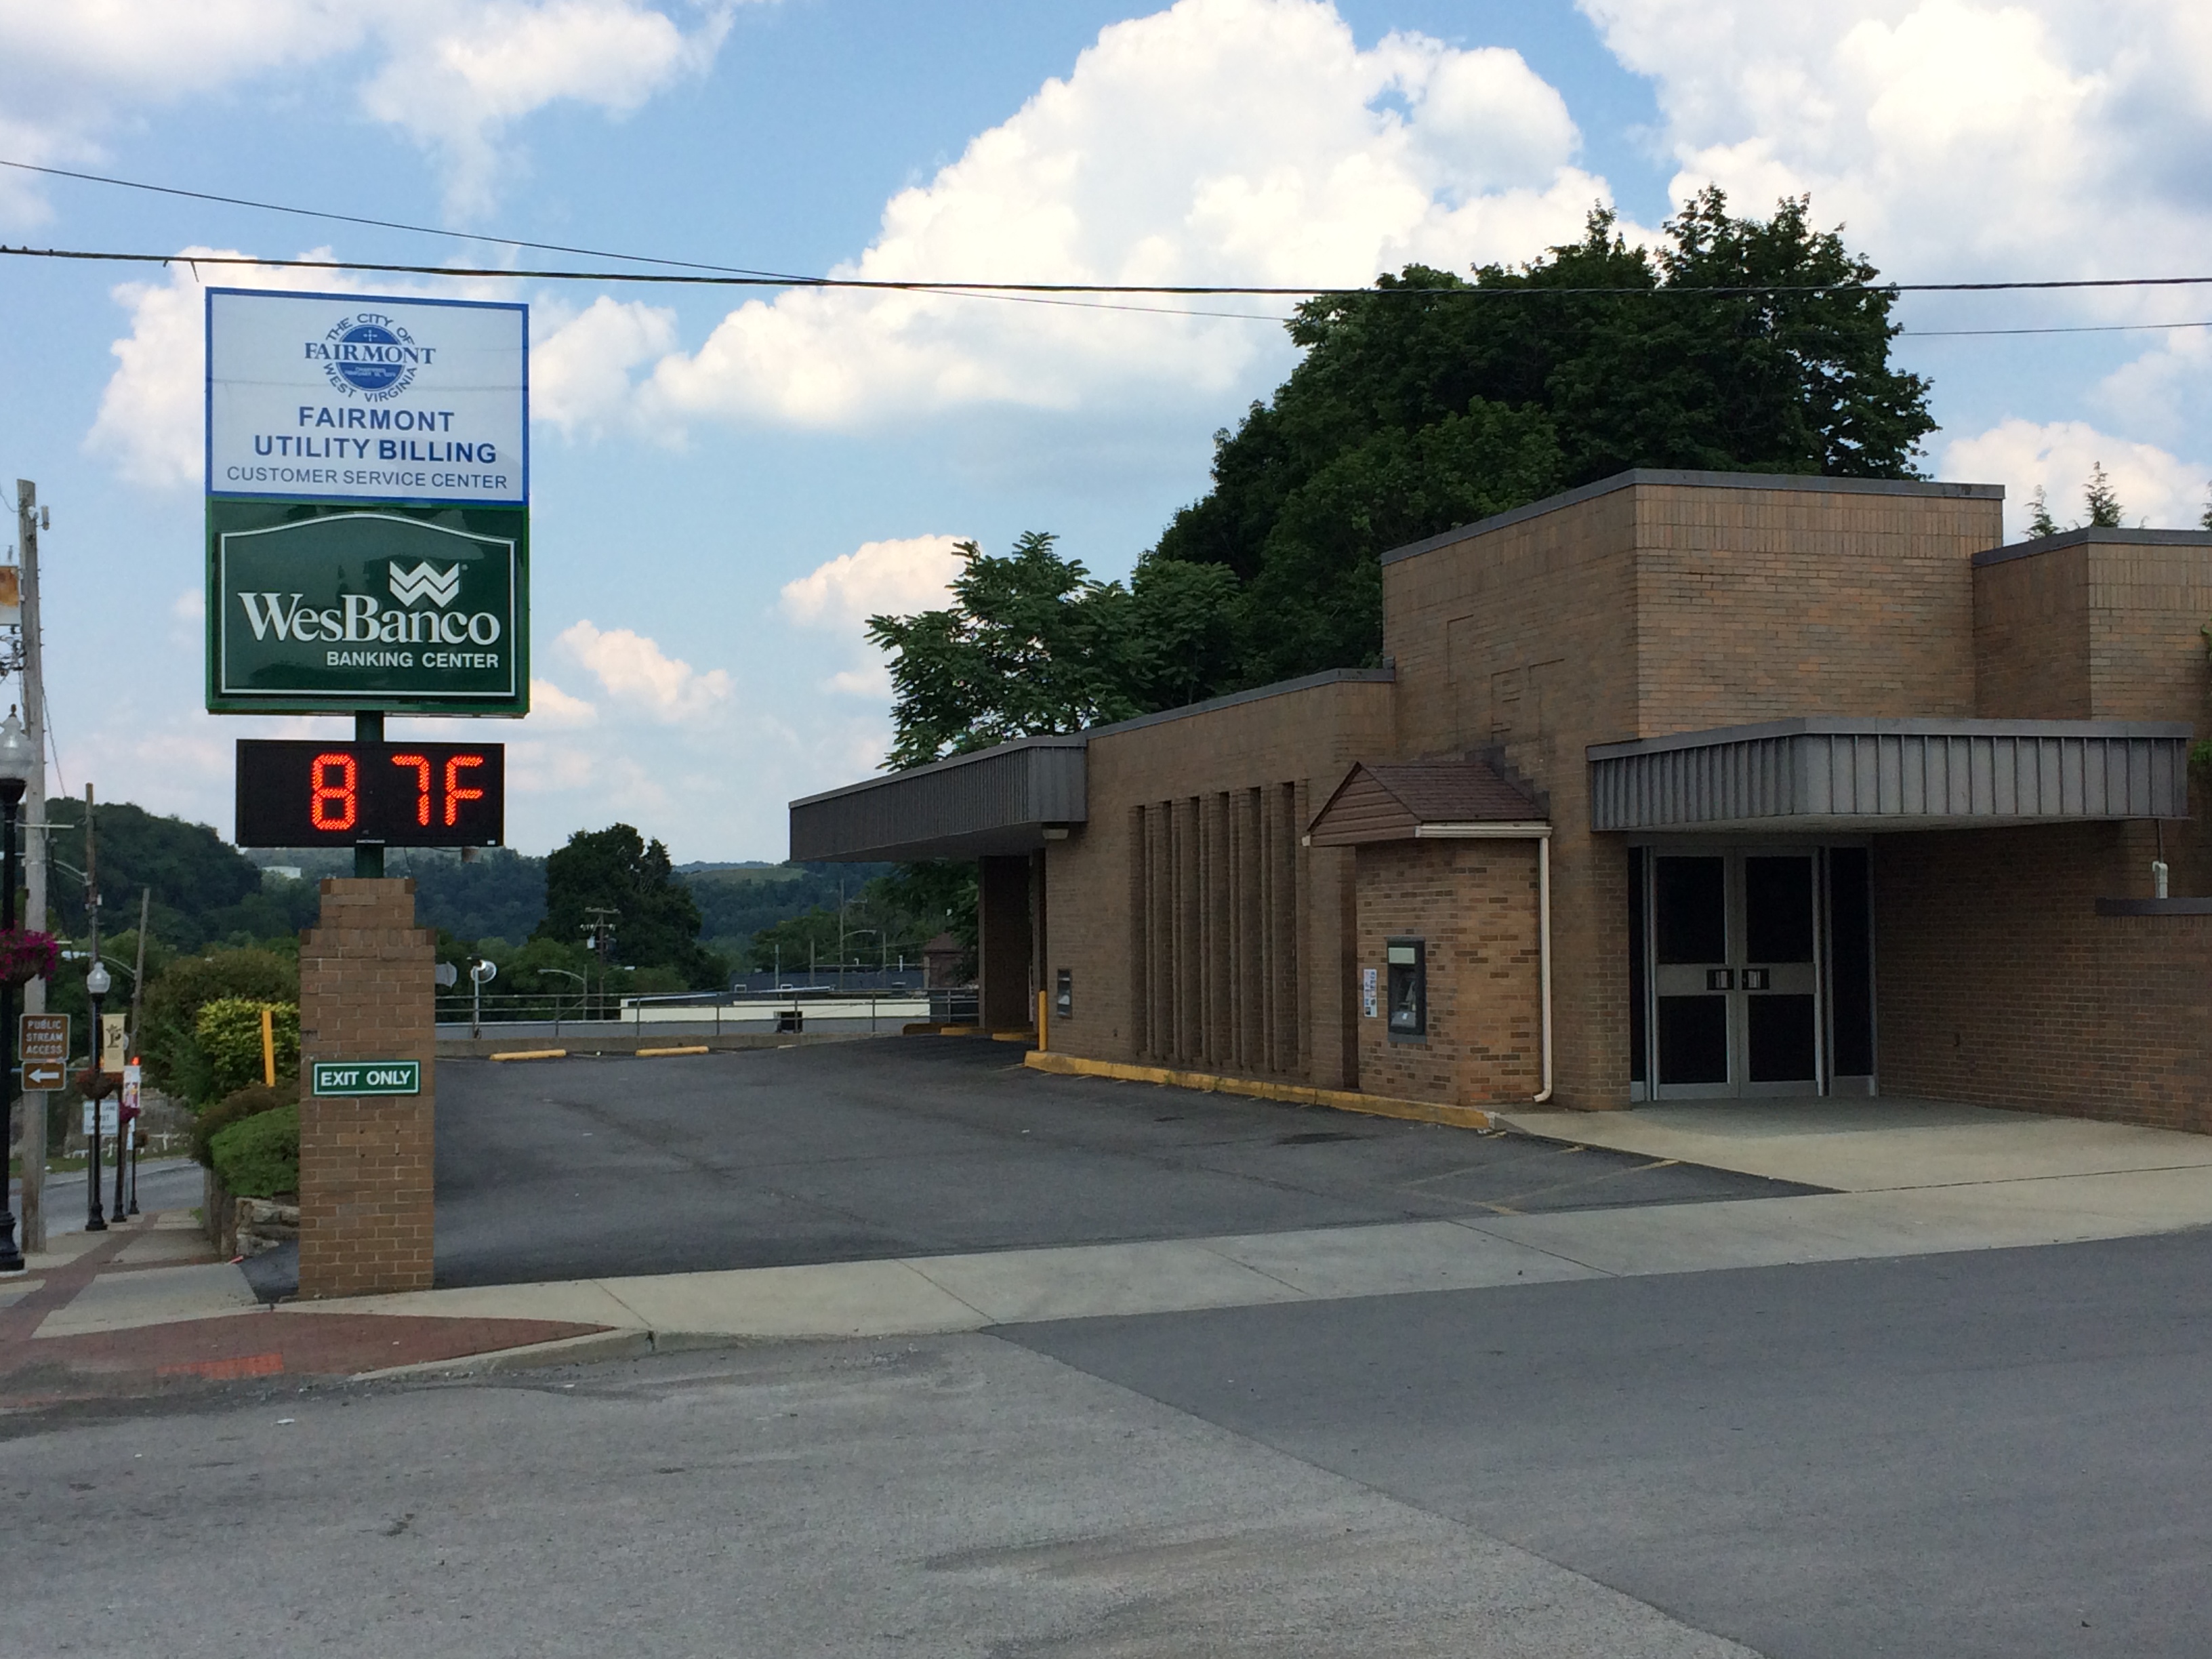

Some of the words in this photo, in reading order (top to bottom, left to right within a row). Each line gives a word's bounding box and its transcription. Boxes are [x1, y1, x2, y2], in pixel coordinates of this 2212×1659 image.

[325, 317, 353, 342] THE
[356, 313, 394, 327] CITY
[396, 327, 415, 346] OF
[305, 342, 436, 365] FAIRMONT
[323, 363, 356, 398] WEST
[364, 367, 417, 403] VIRGINIA
[299, 406, 455, 432] FAIRMONT
[255, 434, 370, 459] UTILITY
[379, 439, 496, 464] BILLING
[227, 466, 338, 483] CUSTOMER
[342, 470, 426, 487] SERVICE
[432, 473, 508, 489] CENTER
[237, 592, 501, 646] WesBanco
[326, 651, 413, 668] BANKING
[422, 653, 499, 668] CENTER
[27, 1020, 62, 1030] PUBLIC
[26, 1032, 63, 1043] STREAM
[26, 1044, 63, 1055] ACCESS
[321, 1071, 360, 1086] EXIT
[366, 1070, 411, 1086] ONLY
